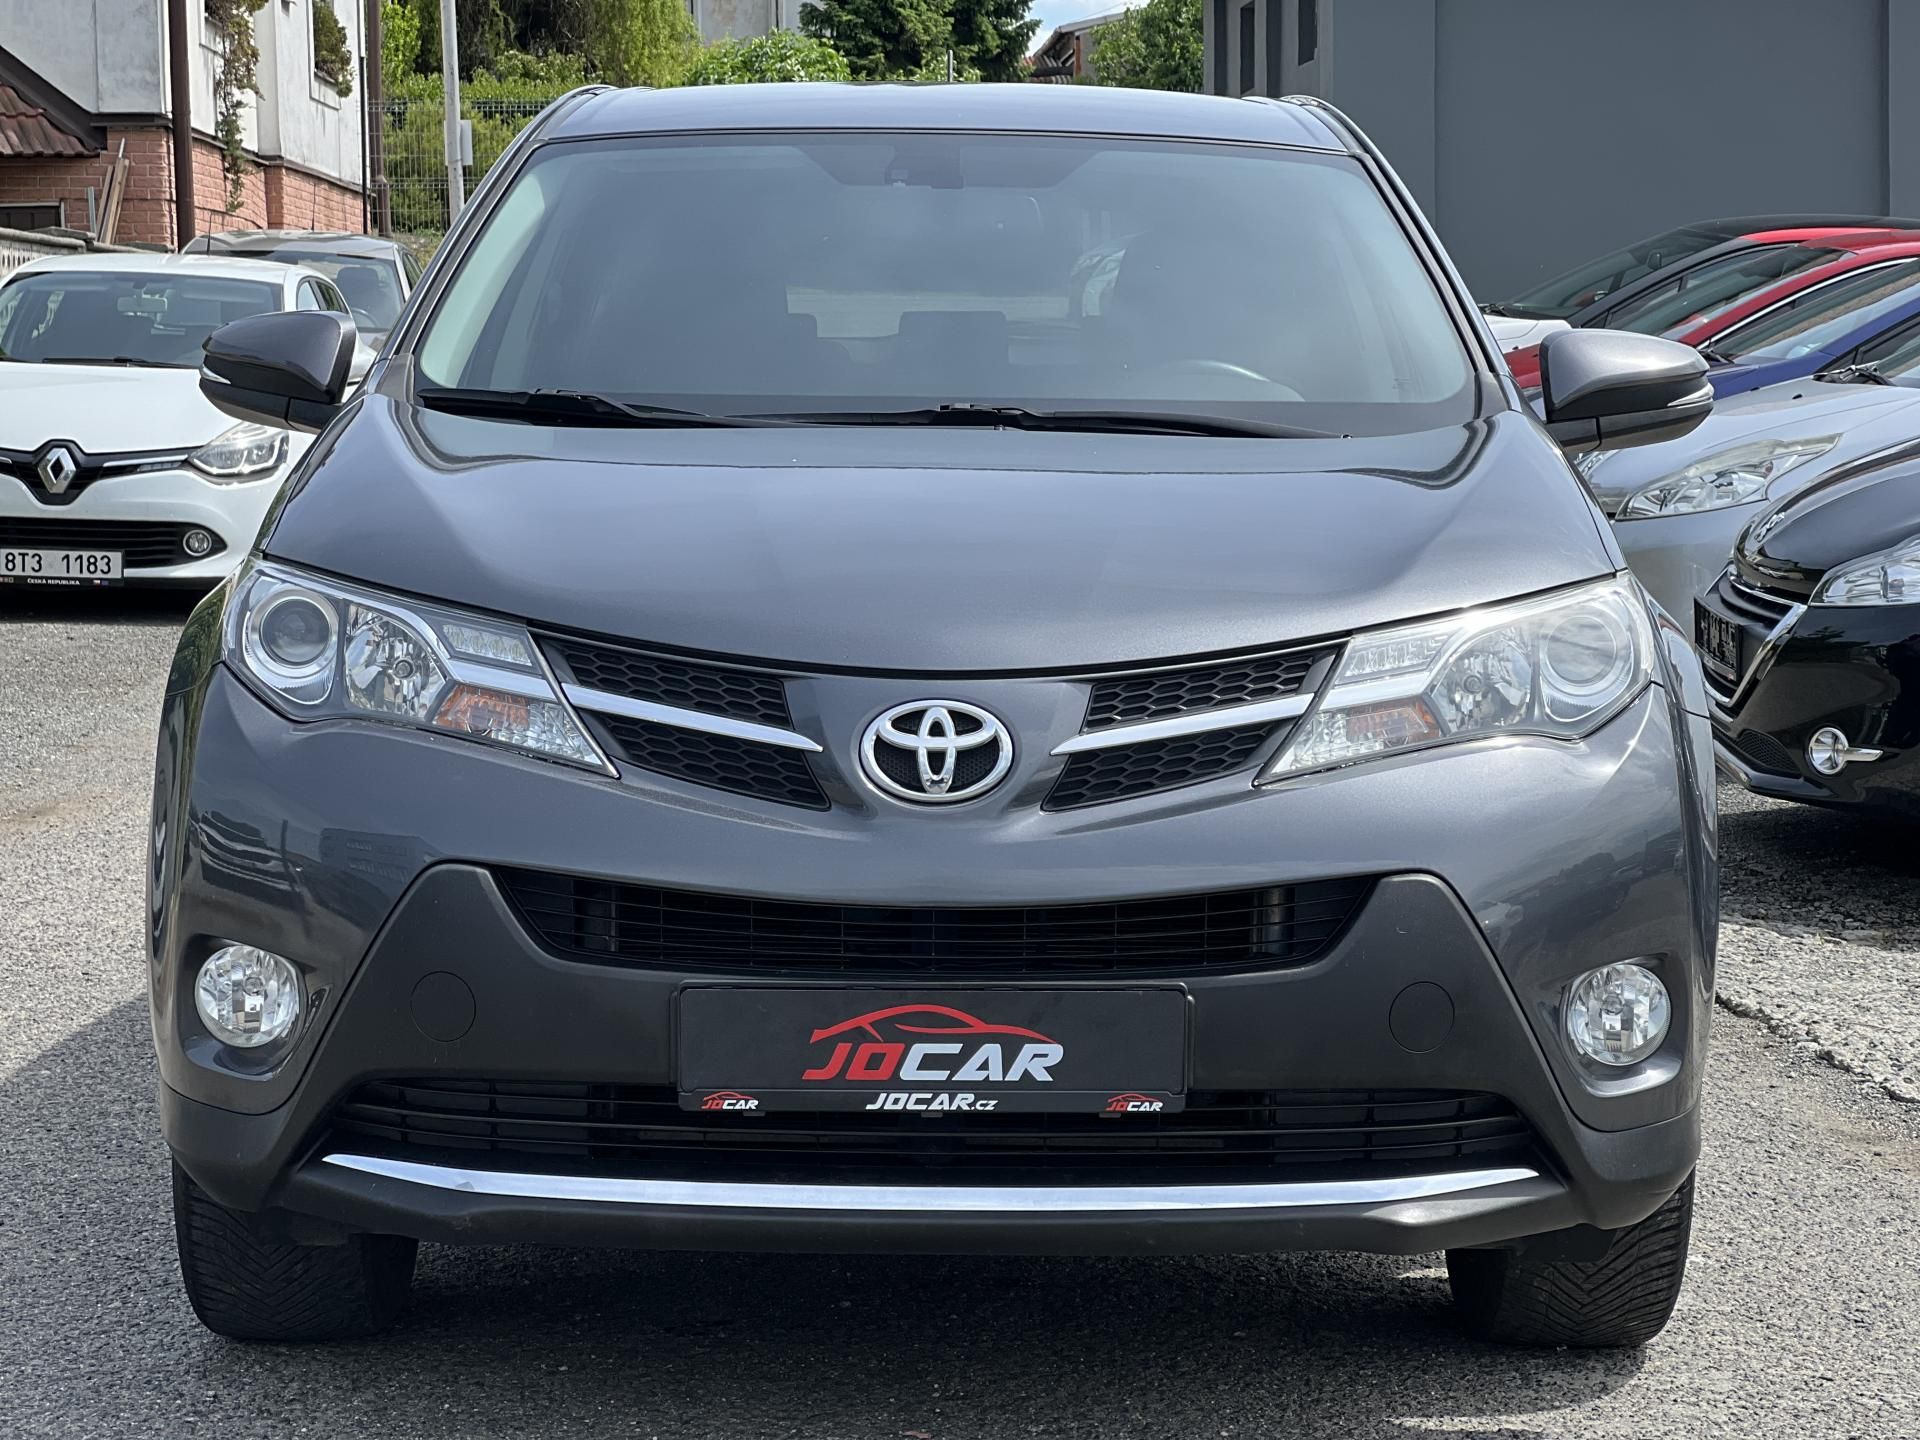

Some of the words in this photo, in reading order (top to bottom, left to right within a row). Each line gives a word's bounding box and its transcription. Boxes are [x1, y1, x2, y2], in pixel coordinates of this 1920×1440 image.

[5, 552, 42, 573] 8T3
[61, 553, 111, 575] 1183
[802, 1043, 1064, 1081] JOCAR
[701, 1099, 759, 1110] JOCAR
[1105, 1101, 1164, 1112] JOCAR
